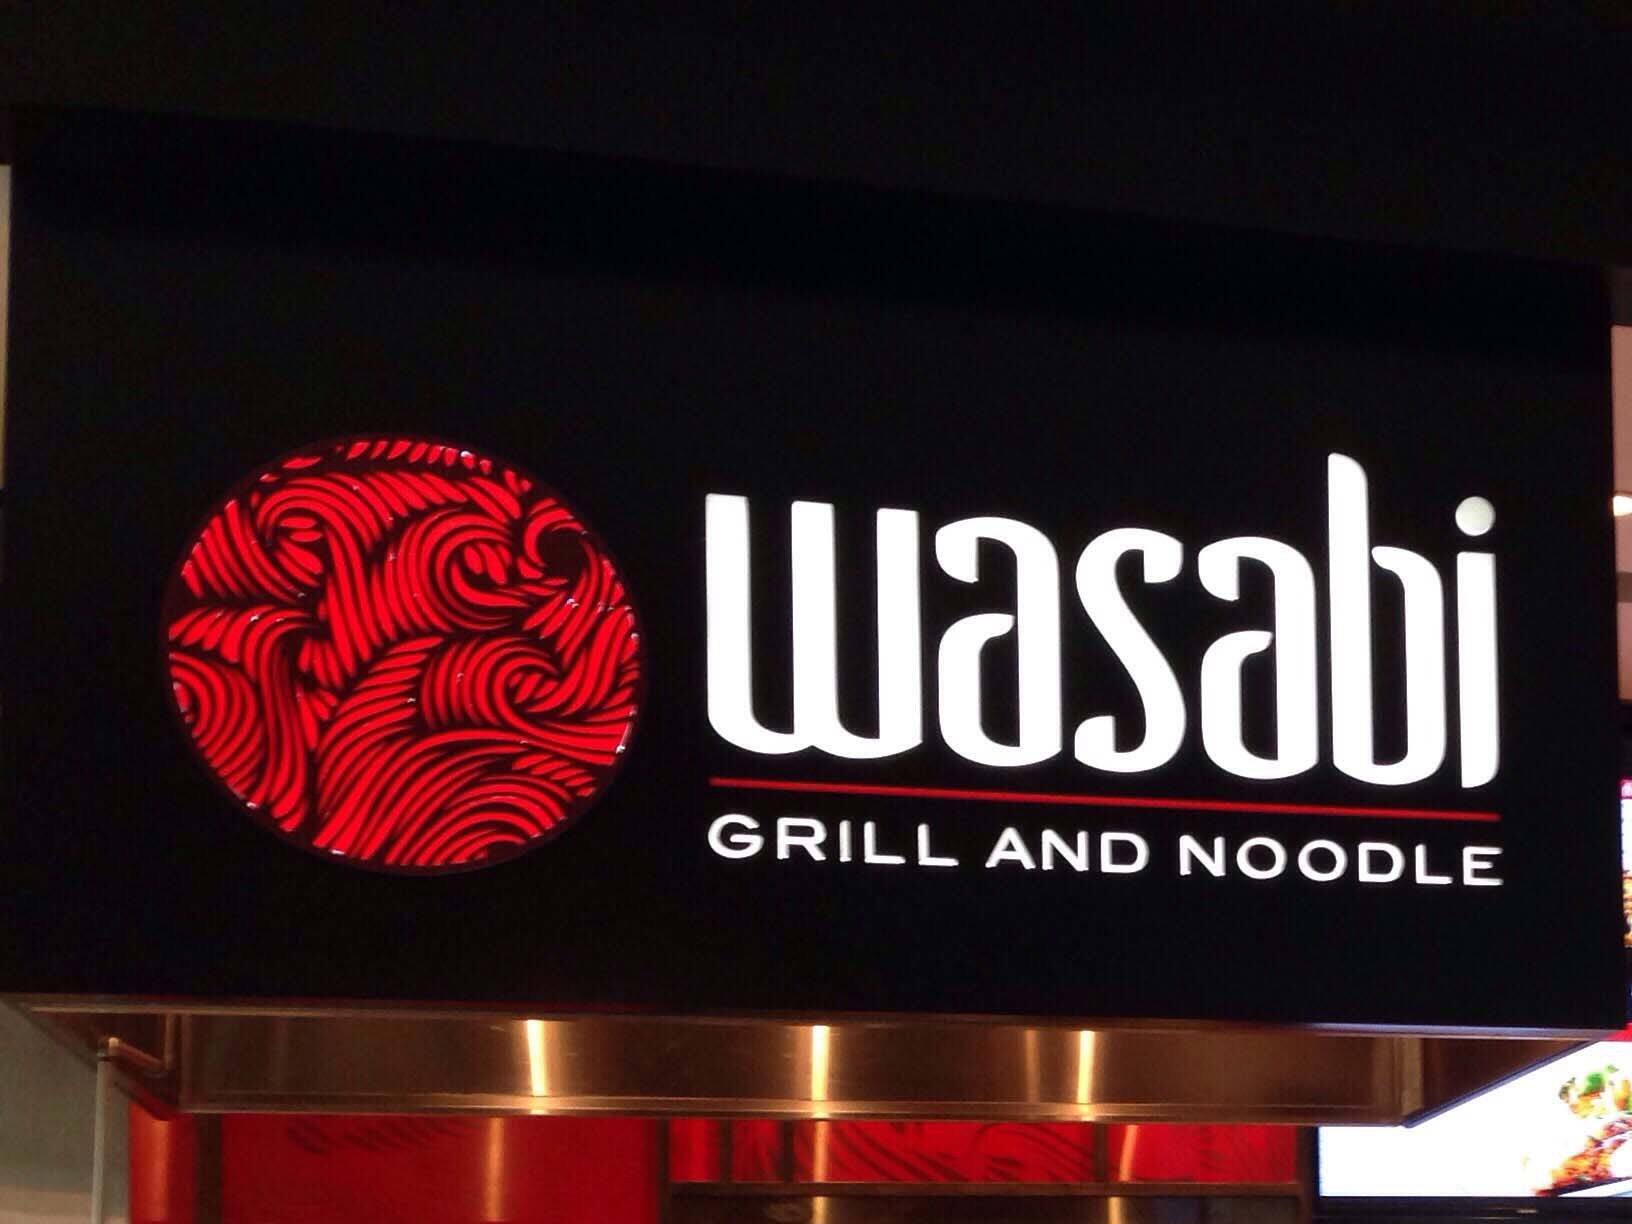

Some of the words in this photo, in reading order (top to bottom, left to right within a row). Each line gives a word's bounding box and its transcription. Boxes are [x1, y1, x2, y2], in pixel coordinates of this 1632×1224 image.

[706, 453, 1499, 788] wasabi
[708, 814, 959, 867] GRILL
[985, 827, 1149, 873] AND
[1179, 834, 1503, 886] NOODLE
